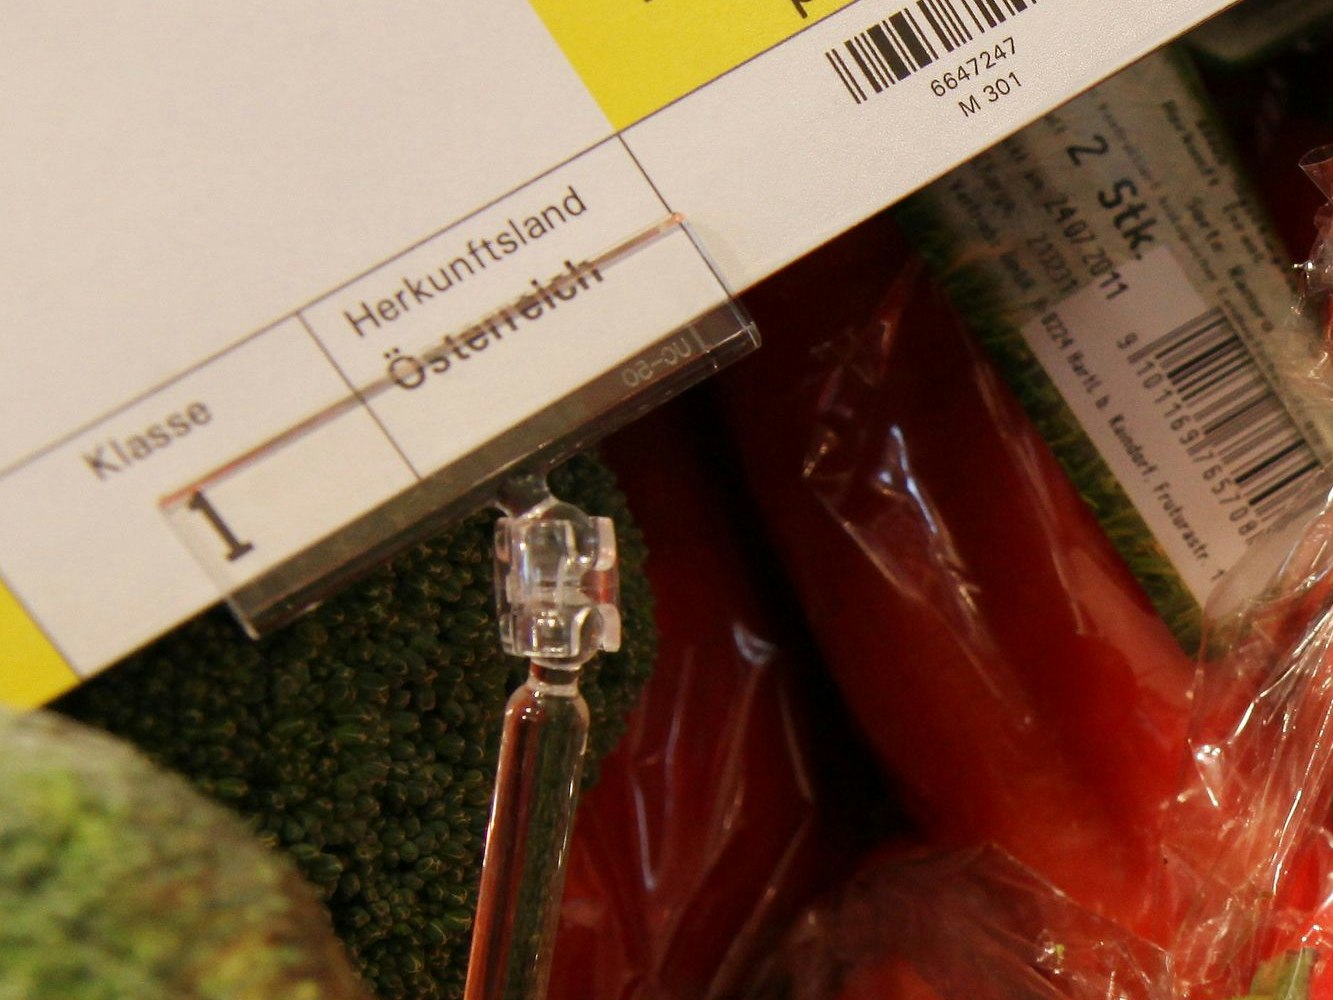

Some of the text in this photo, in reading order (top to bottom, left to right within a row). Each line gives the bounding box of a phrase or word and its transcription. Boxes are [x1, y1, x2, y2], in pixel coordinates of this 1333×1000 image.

[930, 36, 1016, 97] 6647247
[958, 72, 1022, 118] M 301
[1066, 134, 1110, 168] 2
[1097, 178, 1158, 261] Stk.
[342, 185, 589, 338] Herkunftsland
[383, 257, 605, 391] Österreich
[1117, 331, 1138, 350] 9
[1137, 361, 1200, 446] 101169
[81, 400, 213, 480] Klasse
[188, 488, 254, 562] 1
